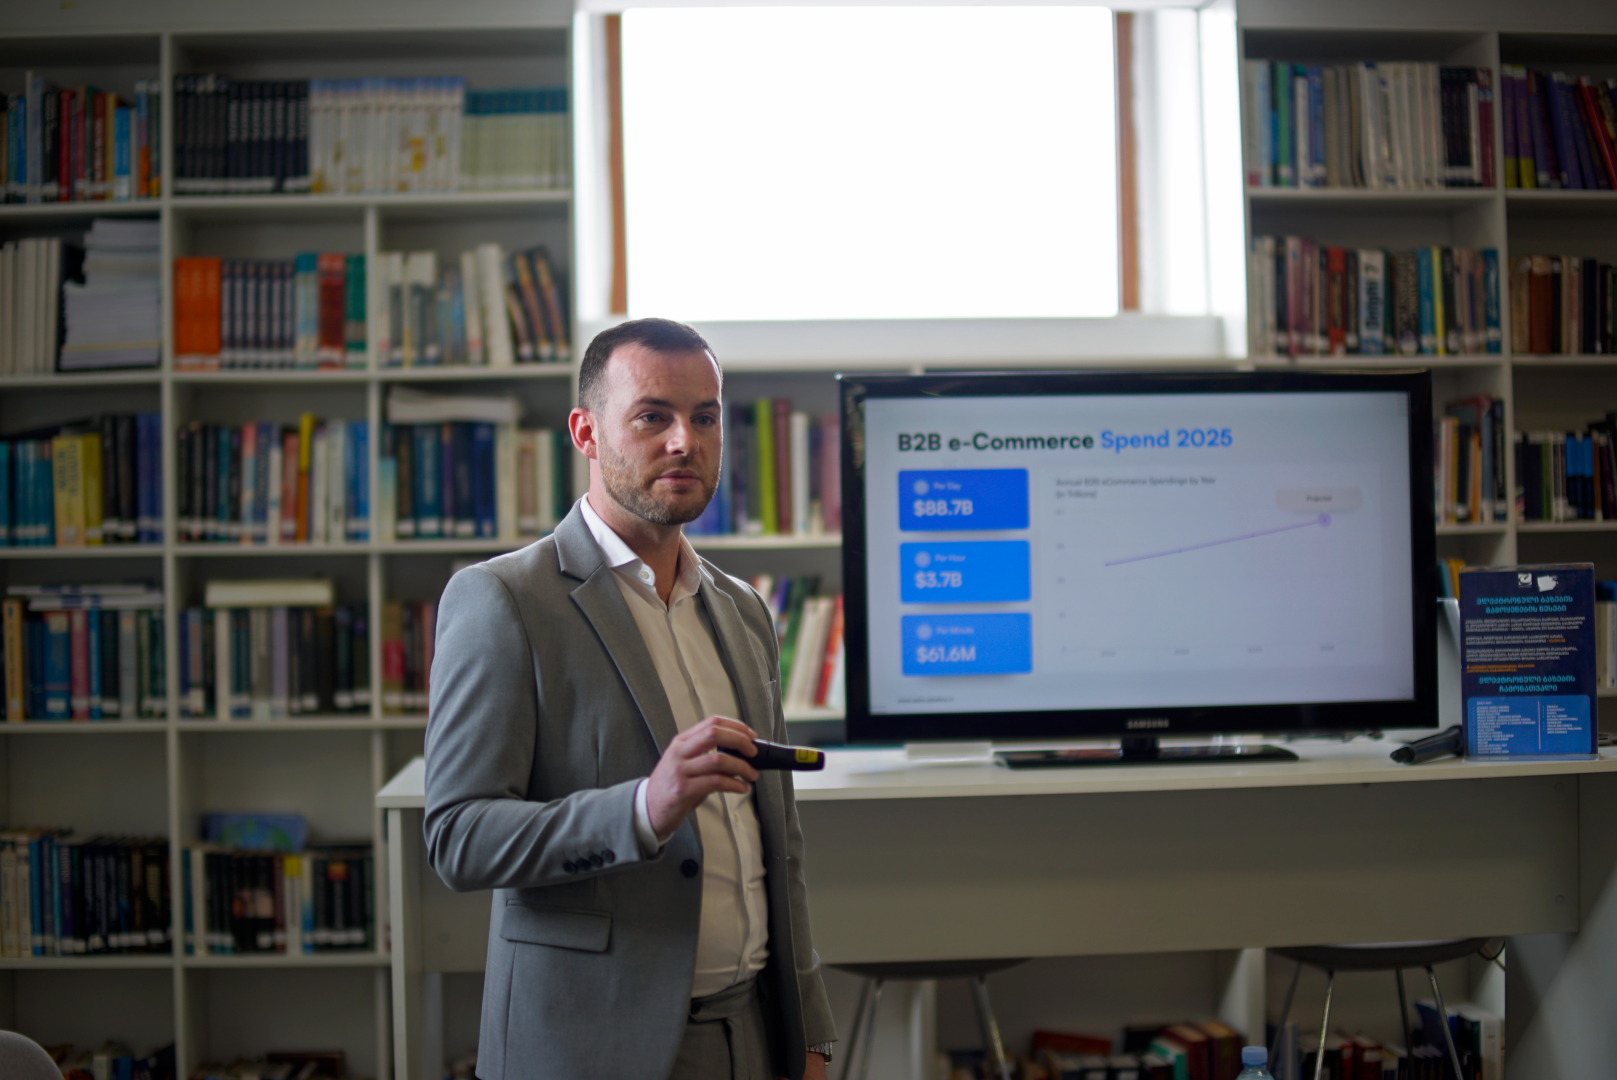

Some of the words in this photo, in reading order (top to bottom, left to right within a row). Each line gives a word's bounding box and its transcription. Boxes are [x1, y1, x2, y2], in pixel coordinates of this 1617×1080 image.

[898, 433, 941, 451] B2B
[948, 432, 1094, 450] e-Commerce
[1101, 429, 1170, 454] Spend
[1177, 429, 1233, 448] 2025
[913, 499, 974, 517] $88.7B
[914, 570, 963, 589] $3.7B
[916, 646, 977, 664] $61.6M
[1126, 717, 1170, 730] SAMSUNG
